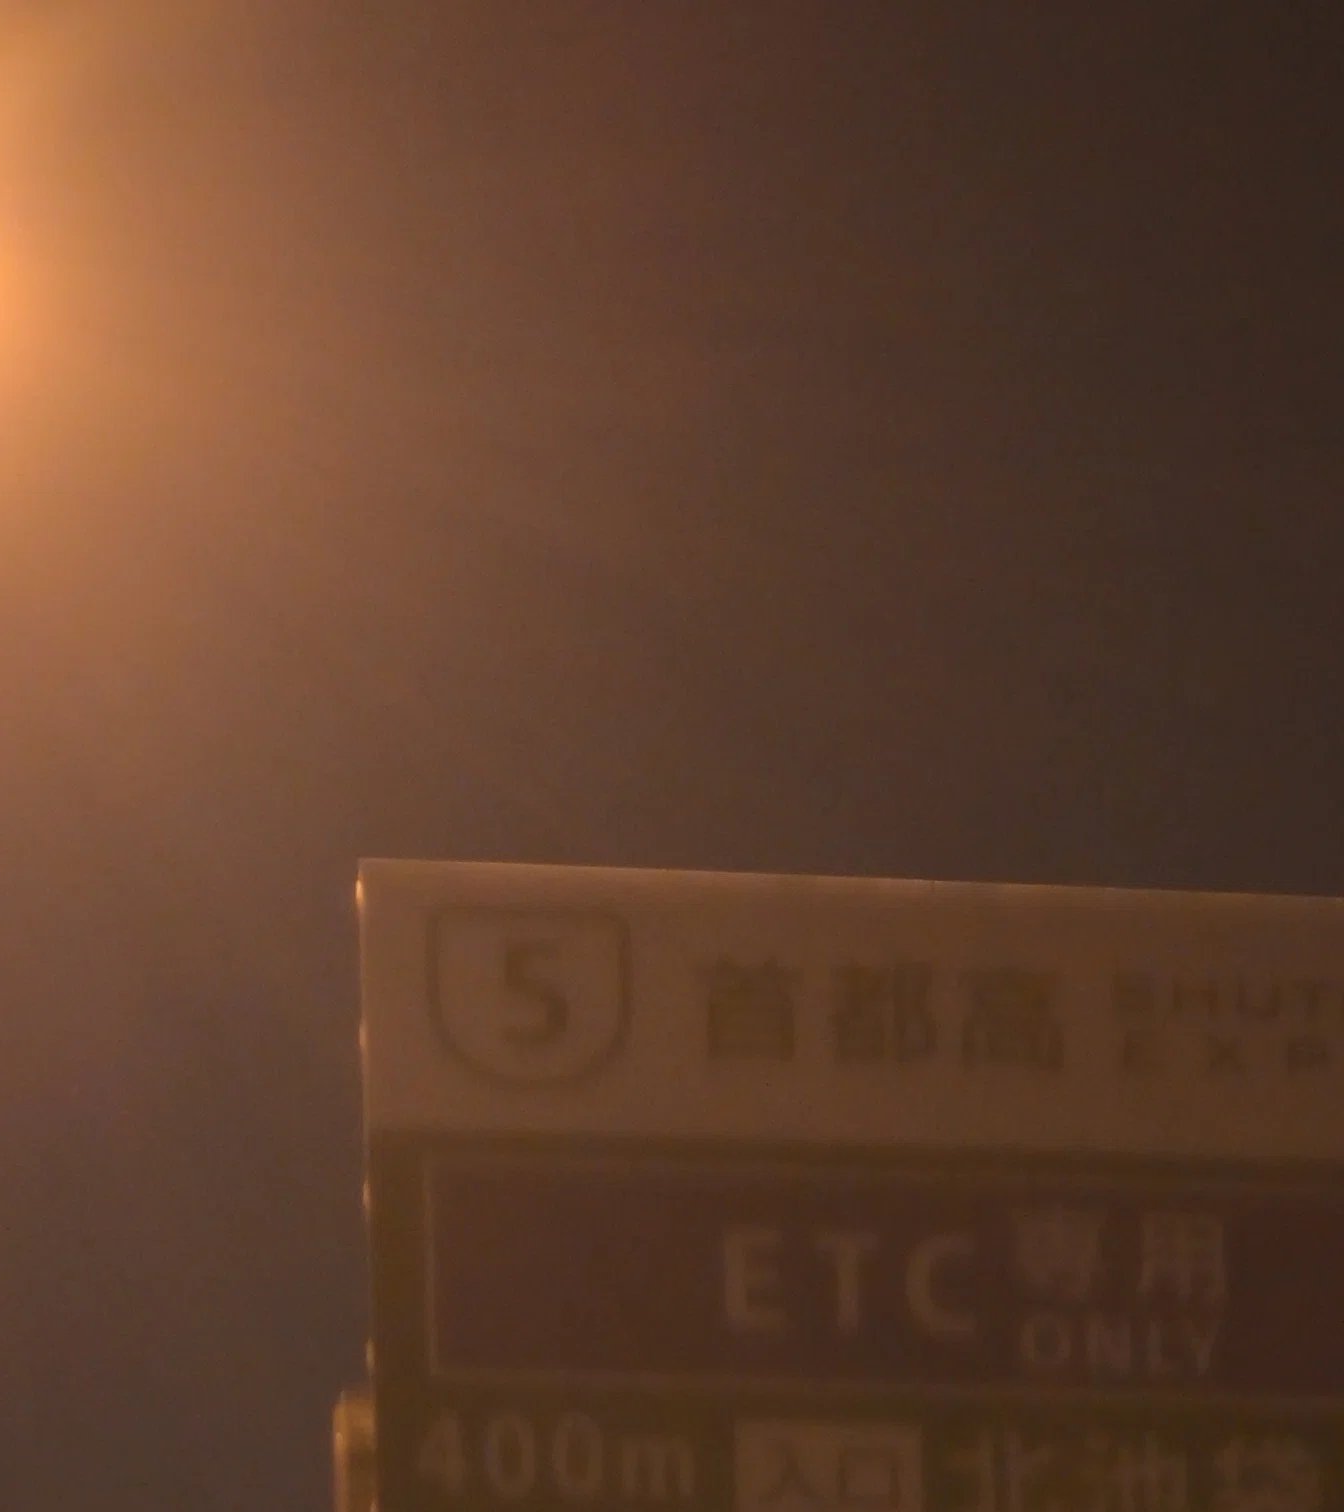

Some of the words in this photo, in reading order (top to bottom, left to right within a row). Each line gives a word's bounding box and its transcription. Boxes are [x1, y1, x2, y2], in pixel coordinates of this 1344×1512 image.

[500, 940, 570, 1044] 5
[702, 952, 1065, 1071] 首都高
[722, 1226, 978, 1342] ETC
[1012, 1209, 1228, 1305] 専用
[1019, 1312, 1221, 1378] ONLY
[417, 1409, 697, 1502] 400m
[760, 1445, 907, 1504] 入口
